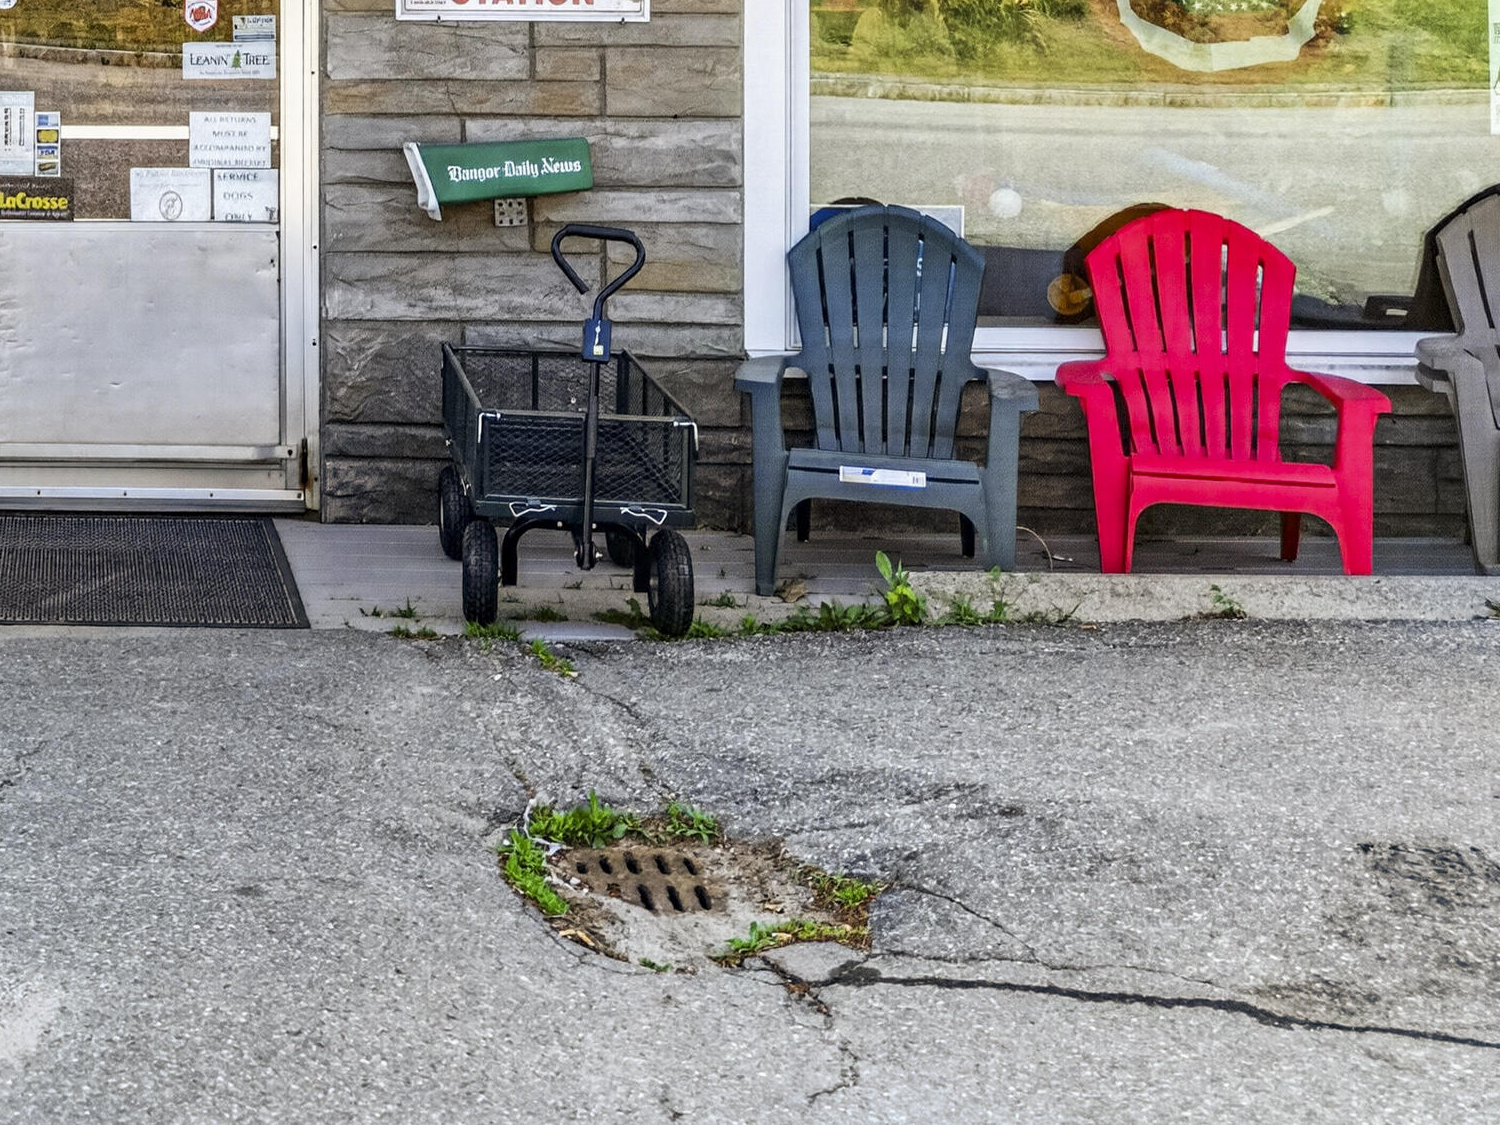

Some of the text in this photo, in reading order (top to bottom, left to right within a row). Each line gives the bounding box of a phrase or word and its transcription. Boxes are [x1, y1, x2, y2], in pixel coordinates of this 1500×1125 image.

[242, 52, 270, 66] TREE
[447, 156, 582, 183] Bangor Daily News
[217, 172, 260, 181] SERVICE
[223, 191, 254, 201] DOGS
